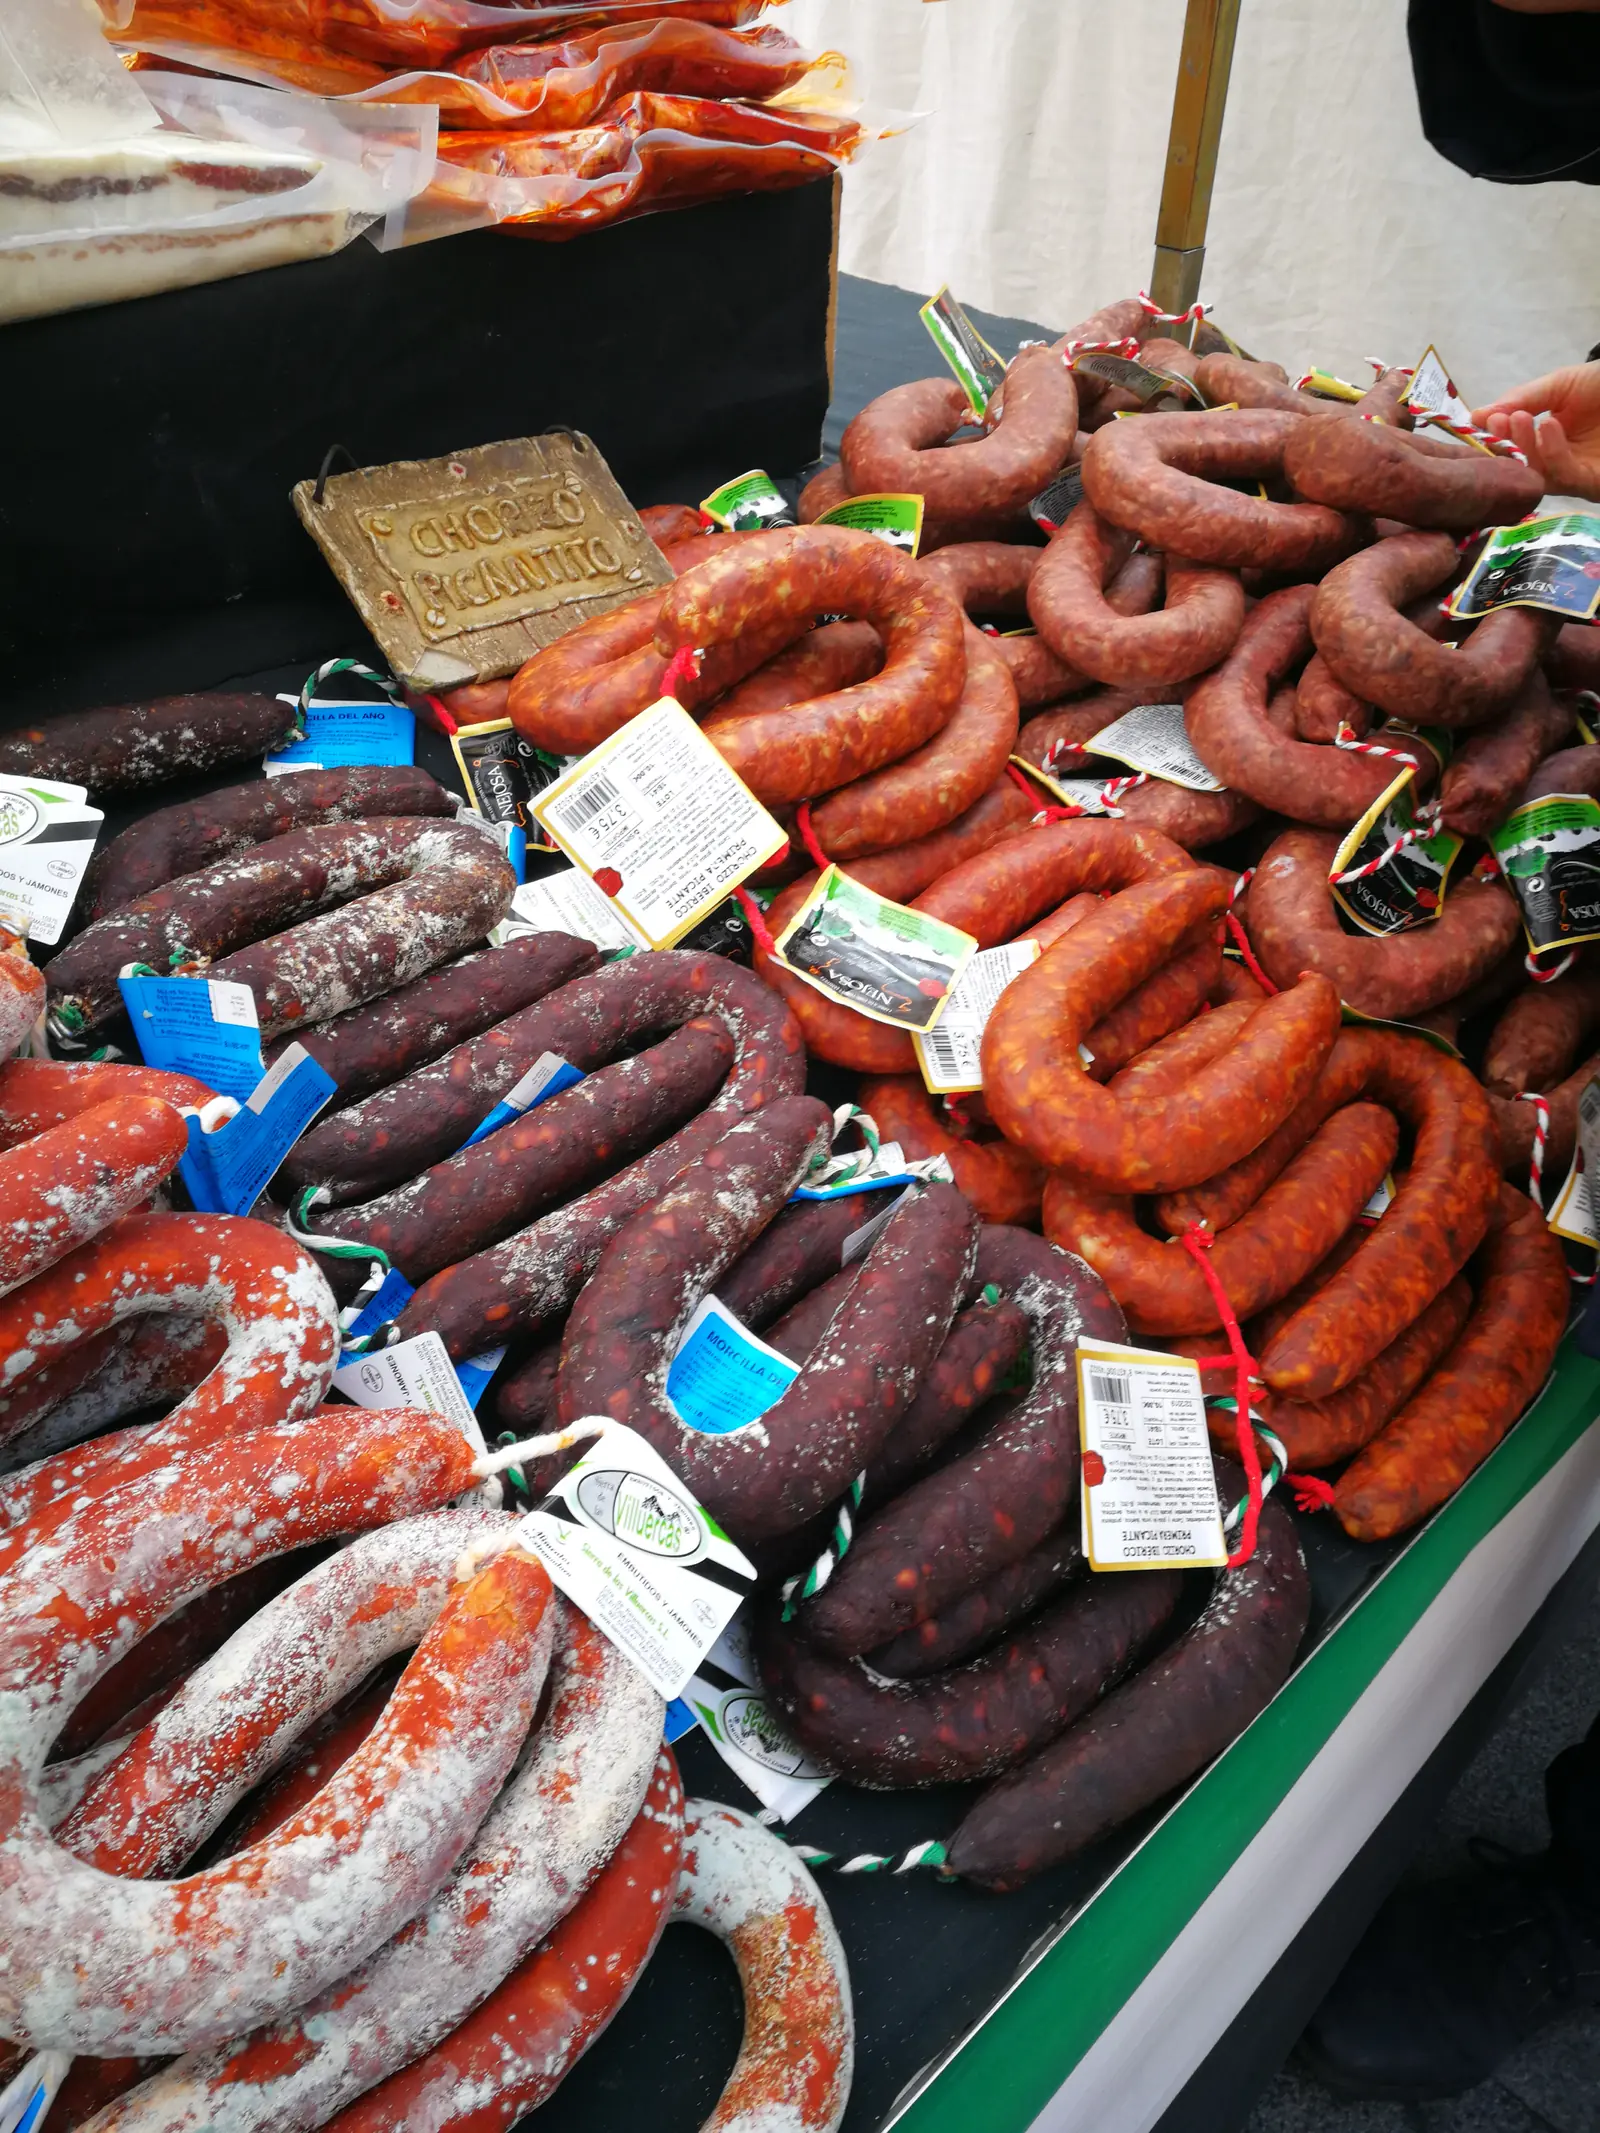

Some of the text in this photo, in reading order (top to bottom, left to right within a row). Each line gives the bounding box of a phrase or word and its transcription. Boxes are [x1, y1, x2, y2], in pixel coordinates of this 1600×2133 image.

[409, 487, 587, 558] CHORIZO
[412, 535, 624, 611] PICANTITO
[1502, 578, 1559, 595] NEJOSA
[487, 764, 515, 816] NEJOSA
[654, 789, 674, 808] LOTE
[587, 824, 602, 840] €
[25, 878, 68, 898] JAMONES
[664, 872, 706, 909] PICANTE
[672, 845, 758, 920] CHORIZO IBÉRICO
[1355, 880, 1397, 921] NEJOSA
[823, 965, 895, 1007] NEJOSA
[706, 1330, 766, 1377] MORCILLA
[384, 1353, 412, 1405] Y JAMONES
[616, 1493, 681, 1553] Villuercas
[1121, 1528, 1158, 1542] PICANTE
[1122, 1543, 1195, 1560] CHORIZO IBÉRICO
[578, 1541, 606, 1569] Sierra
[600, 1564, 615, 1579] de
[609, 1574, 627, 1591] las
[620, 1586, 660, 1627] Villuercas
[615, 1551, 662, 1602] EMBUTIDOS
[659, 1599, 669, 1609] Y
[665, 1606, 705, 1649] JAMONES
